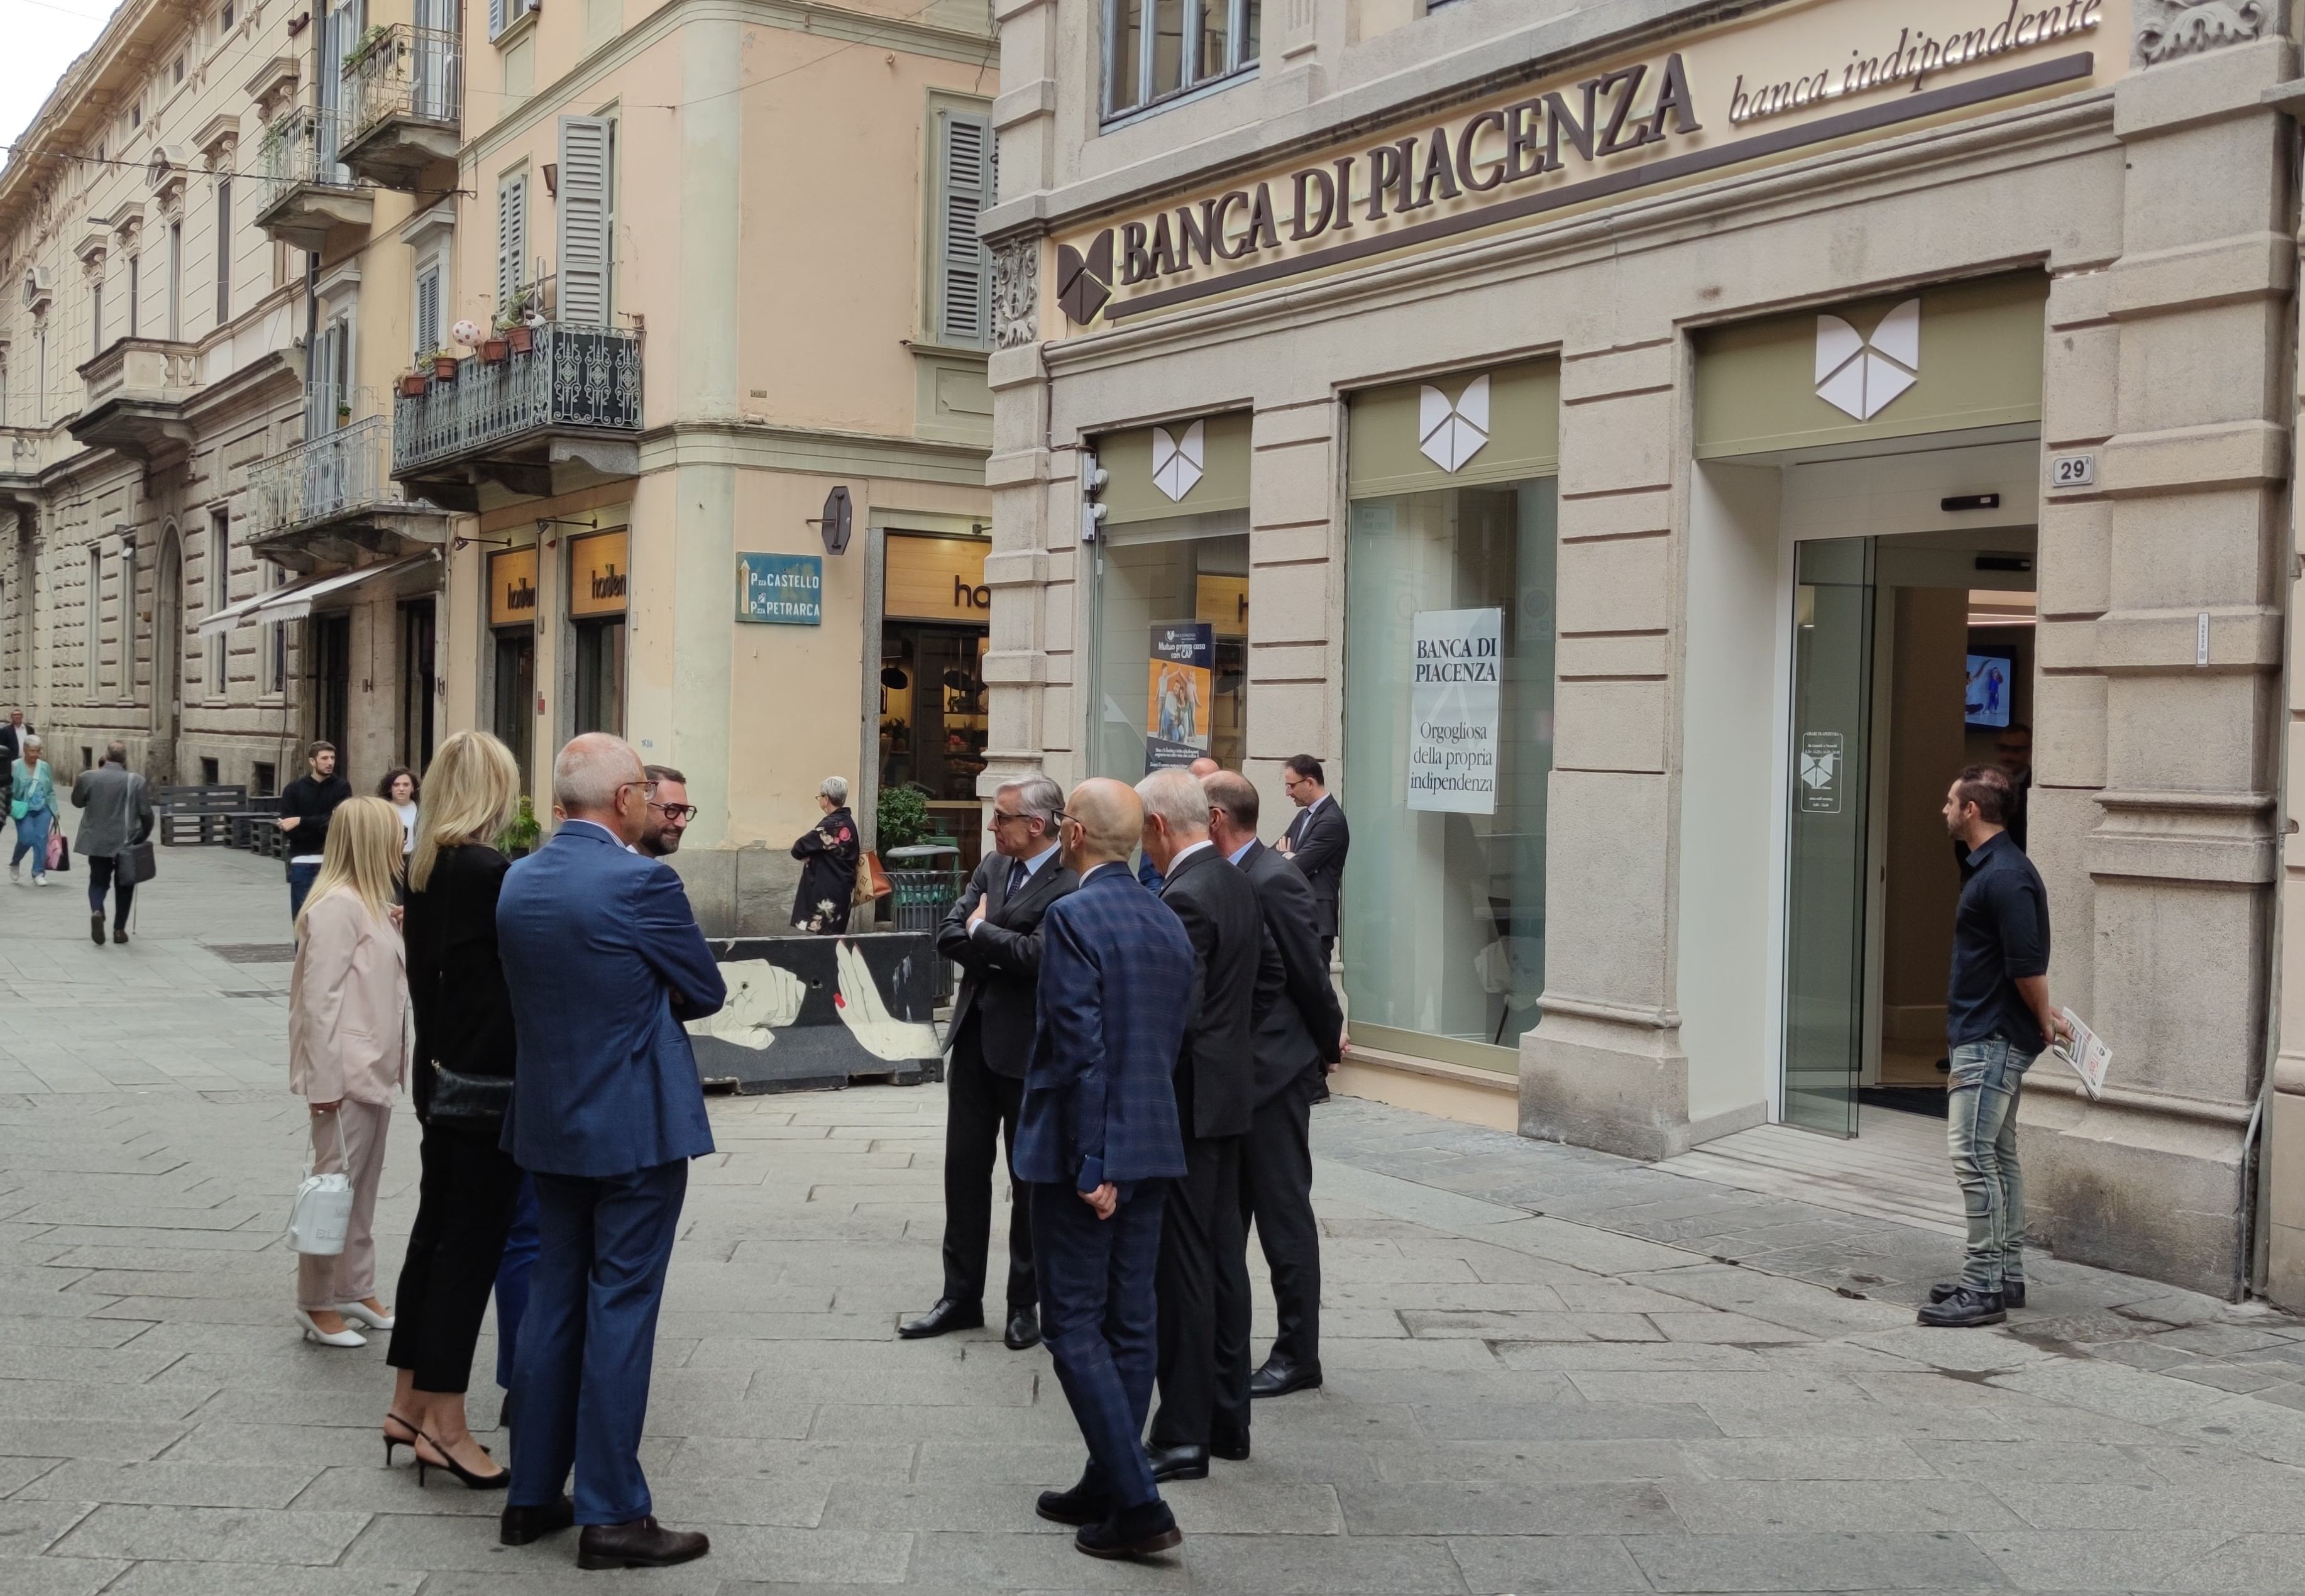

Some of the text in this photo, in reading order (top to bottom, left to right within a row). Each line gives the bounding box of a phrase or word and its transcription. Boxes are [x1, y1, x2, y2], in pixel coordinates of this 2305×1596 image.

[1729, 0, 2102, 124] banca indipendente
[1121, 53, 1703, 286] BANCA DI PIACENZA
[767, 573, 819, 588] CASTELLO
[767, 602, 820, 616] PETRARCA
[1417, 637, 1497, 659] BANCA DI
[1415, 662, 1497, 683] PIACENZA
[1421, 722, 1487, 744] Orgogliosa
[1414, 746, 1493, 771] della propria
[1410, 771, 1493, 795] indipendenza
